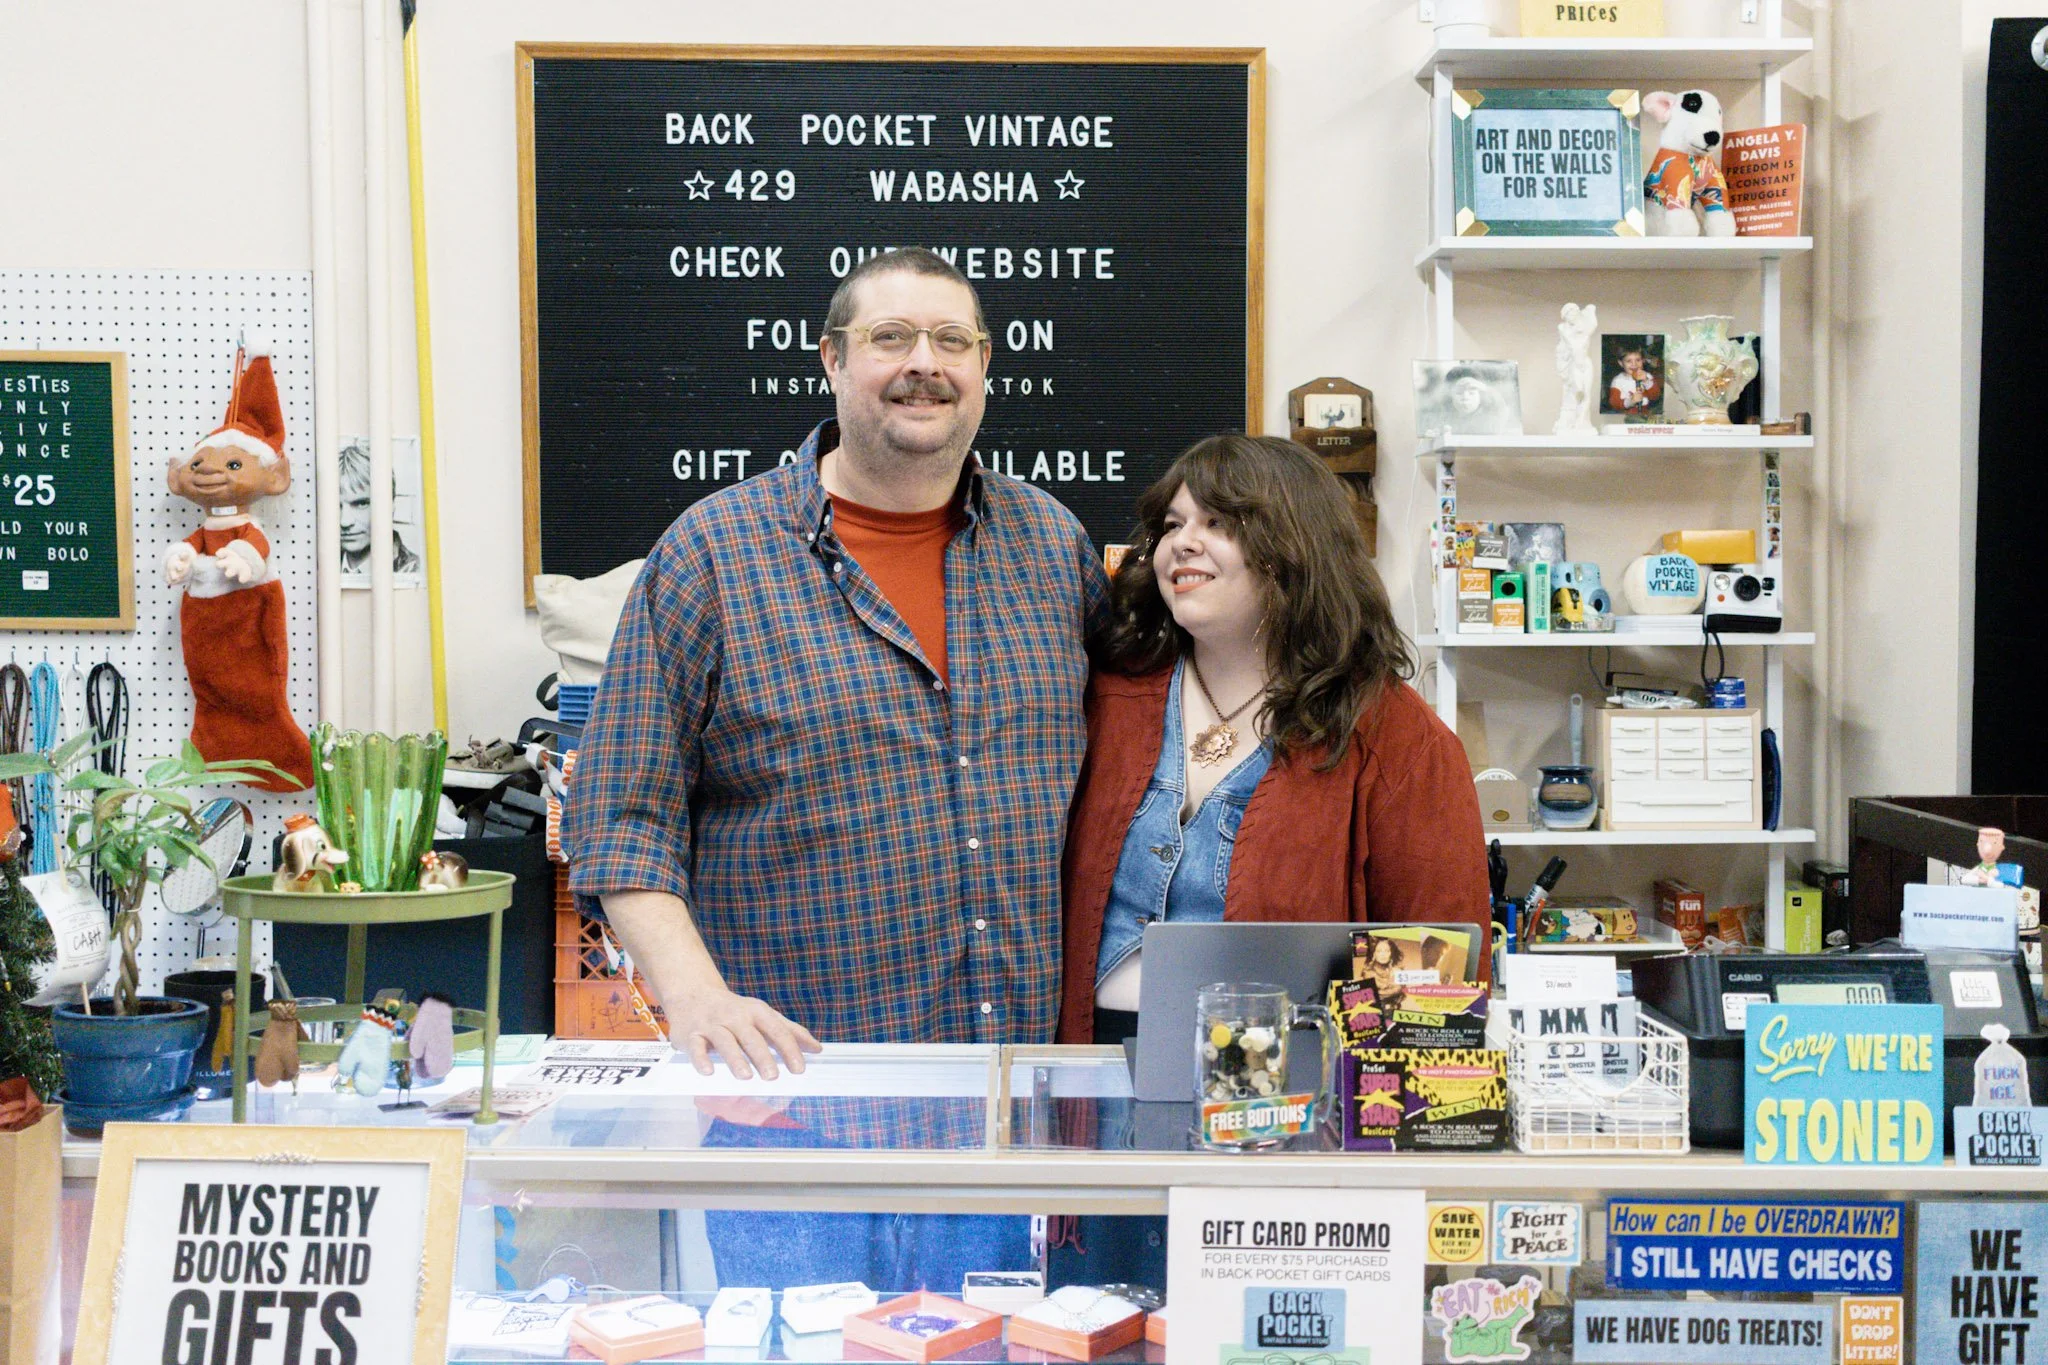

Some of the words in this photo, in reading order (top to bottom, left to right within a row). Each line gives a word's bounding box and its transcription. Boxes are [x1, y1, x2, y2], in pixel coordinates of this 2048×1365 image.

[665, 113, 754, 145] BACK
[801, 114, 937, 147] POCKET
[964, 115, 1114, 148] VINTAGE
[1476, 128, 1509, 150] ART
[1516, 129, 1552, 150] AND
[1558, 129, 1617, 151] DECOR
[1725, 132, 1780, 149] ANGELA
[1785, 130, 1797, 141] Y.
[1482, 152, 1506, 174] ON
[1512, 153, 1545, 174] THE
[1551, 153, 1612, 175] WALLS
[1740, 147, 1781, 161] DAVIS
[1726, 162, 1779, 177] FREEDOM
[1784, 160, 1794, 168] IS
[724, 171, 797, 201] 429
[870, 171, 1040, 202] WABASHA
[1503, 177, 1537, 198] FOR
[1543, 177, 1588, 199] SALE
[1735, 174, 1795, 189] CONSTANT
[1730, 189, 1788, 204] STRUGGLE
[669, 246, 785, 278] CHECK
[830, 247, 898, 278] OU
[747, 319, 820, 351] FOL
[1006, 320, 1053, 351] ON
[0, 375, 70, 394] ESTIES
[751, 377, 831, 395] INSTA
[984, 378, 1054, 396] KTOK
[0, 400, 70, 416] NLY
[0, 422, 71, 436] IVE
[1316, 437, 1351, 446] LETTER
[672, 450, 752, 480] GIFT
[993, 450, 1126, 481] ILABLE
[44, 521, 88, 536] YOUR
[47, 546, 89, 562] BOLO
[1660, 557, 1689, 567] BACK
[1655, 567, 1695, 580] POCKET
[1679, 900, 1701, 911] fun
[1398, 974, 1408, 983] $3
[1728, 973, 1764, 982] CASIO
[1398, 1013, 1440, 1025] WIN
[1539, 1007, 1590, 1037] MM
[1755, 1015, 1836, 1077] Sorry
[1846, 1033, 1933, 1072] WE'RE
[1362, 1064, 1385, 1073] ProSet
[1983, 1066, 2020, 1080] FUCK
[1990, 1085, 2015, 1100] ICE
[1210, 1111, 1243, 1133] FREE
[1247, 1104, 1307, 1128] BUTTONS
[1359, 1104, 1400, 1126] STARS
[1432, 1103, 1475, 1118] WIN
[1755, 1098, 1934, 1163] STONED
[1979, 1111, 2031, 1133] BACK
[1969, 1134, 2042, 1157] POCKET
[178, 1183, 380, 1237] MYSTERY
[1442, 1213, 1474, 1224] SAVE
[1510, 1211, 1567, 1229] FIGHT
[1613, 1206, 1657, 1233] How
[1665, 1213, 1700, 1233] can
[1707, 1208, 1717, 1232] I
[1722, 1209, 1746, 1233] be
[1755, 1208, 1895, 1236] OVERDRAWN?
[1202, 1220, 1245, 1245] GIFT
[1252, 1221, 1307, 1247] CARD
[1315, 1223, 1391, 1248] PROMO
[1435, 1227, 1481, 1239] WATER
[1531, 1229, 1548, 1239] for
[1510, 1237, 1568, 1255] PEACE
[1970, 1229, 2022, 1271] WE
[172, 1240, 289, 1285] BOOKS
[299, 1242, 372, 1285] AND
[1204, 1253, 1232, 1265] FOR
[1235, 1253, 1278, 1266] EVERY
[1281, 1254, 1303, 1267] $75
[1306, 1255, 1388, 1268] PURCHASED
[1613, 1246, 1622, 1278] I
[1631, 1247, 1700, 1279] STILL
[1709, 1248, 1779, 1280] HAVE
[1788, 1249, 1893, 1282] CHECKS
[1200, 1268, 1214, 1279] IN
[1217, 1268, 1252, 1280] BACK
[1256, 1269, 1309, 1281] POCKET
[1312, 1270, 1342, 1282] GIFT
[1345, 1270, 1391, 1283] CARDS
[1270, 1291, 1323, 1314] BACK
[1443, 1282, 1484, 1318] EAT
[1951, 1276, 2038, 1318] HAVE
[1849, 1304, 1894, 1320] DON'T
[160, 1289, 362, 1365] GIFTS
[1259, 1314, 1333, 1336] POCKET
[1586, 1316, 1617, 1343] WE
[1626, 1317, 1679, 1344] HAVE
[1687, 1318, 1729, 1345] DOG
[1738, 1319, 1823, 1347] TREATS!
[1851, 1324, 1894, 1340] DROP
[1845, 1344, 1898, 1359] LITTER!
[1959, 1323, 2030, 1365] GIFT
